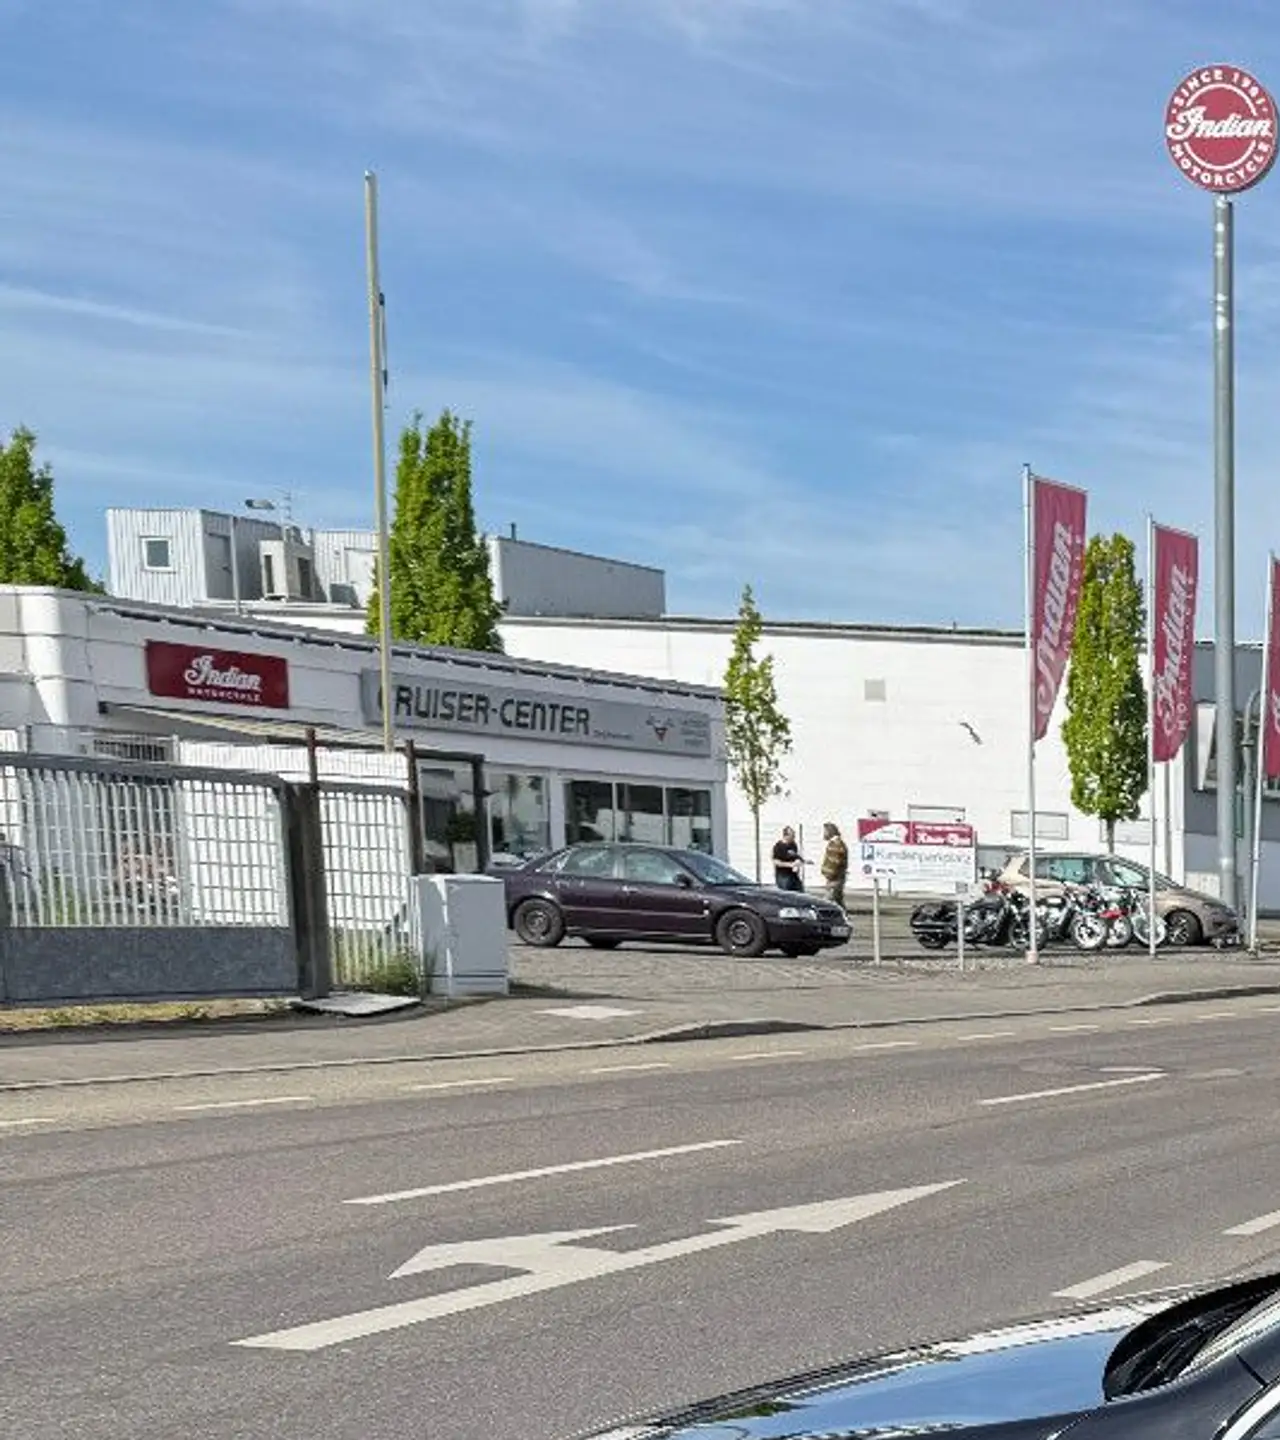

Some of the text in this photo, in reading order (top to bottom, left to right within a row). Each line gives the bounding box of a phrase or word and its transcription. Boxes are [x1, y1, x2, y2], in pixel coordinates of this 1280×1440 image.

[1173, 69, 1223, 107] SINCE
[1166, 105, 1273, 140] Indian
[184, 655, 263, 692] Indian
[378, 684, 590, 736] RUISER-CENTER
